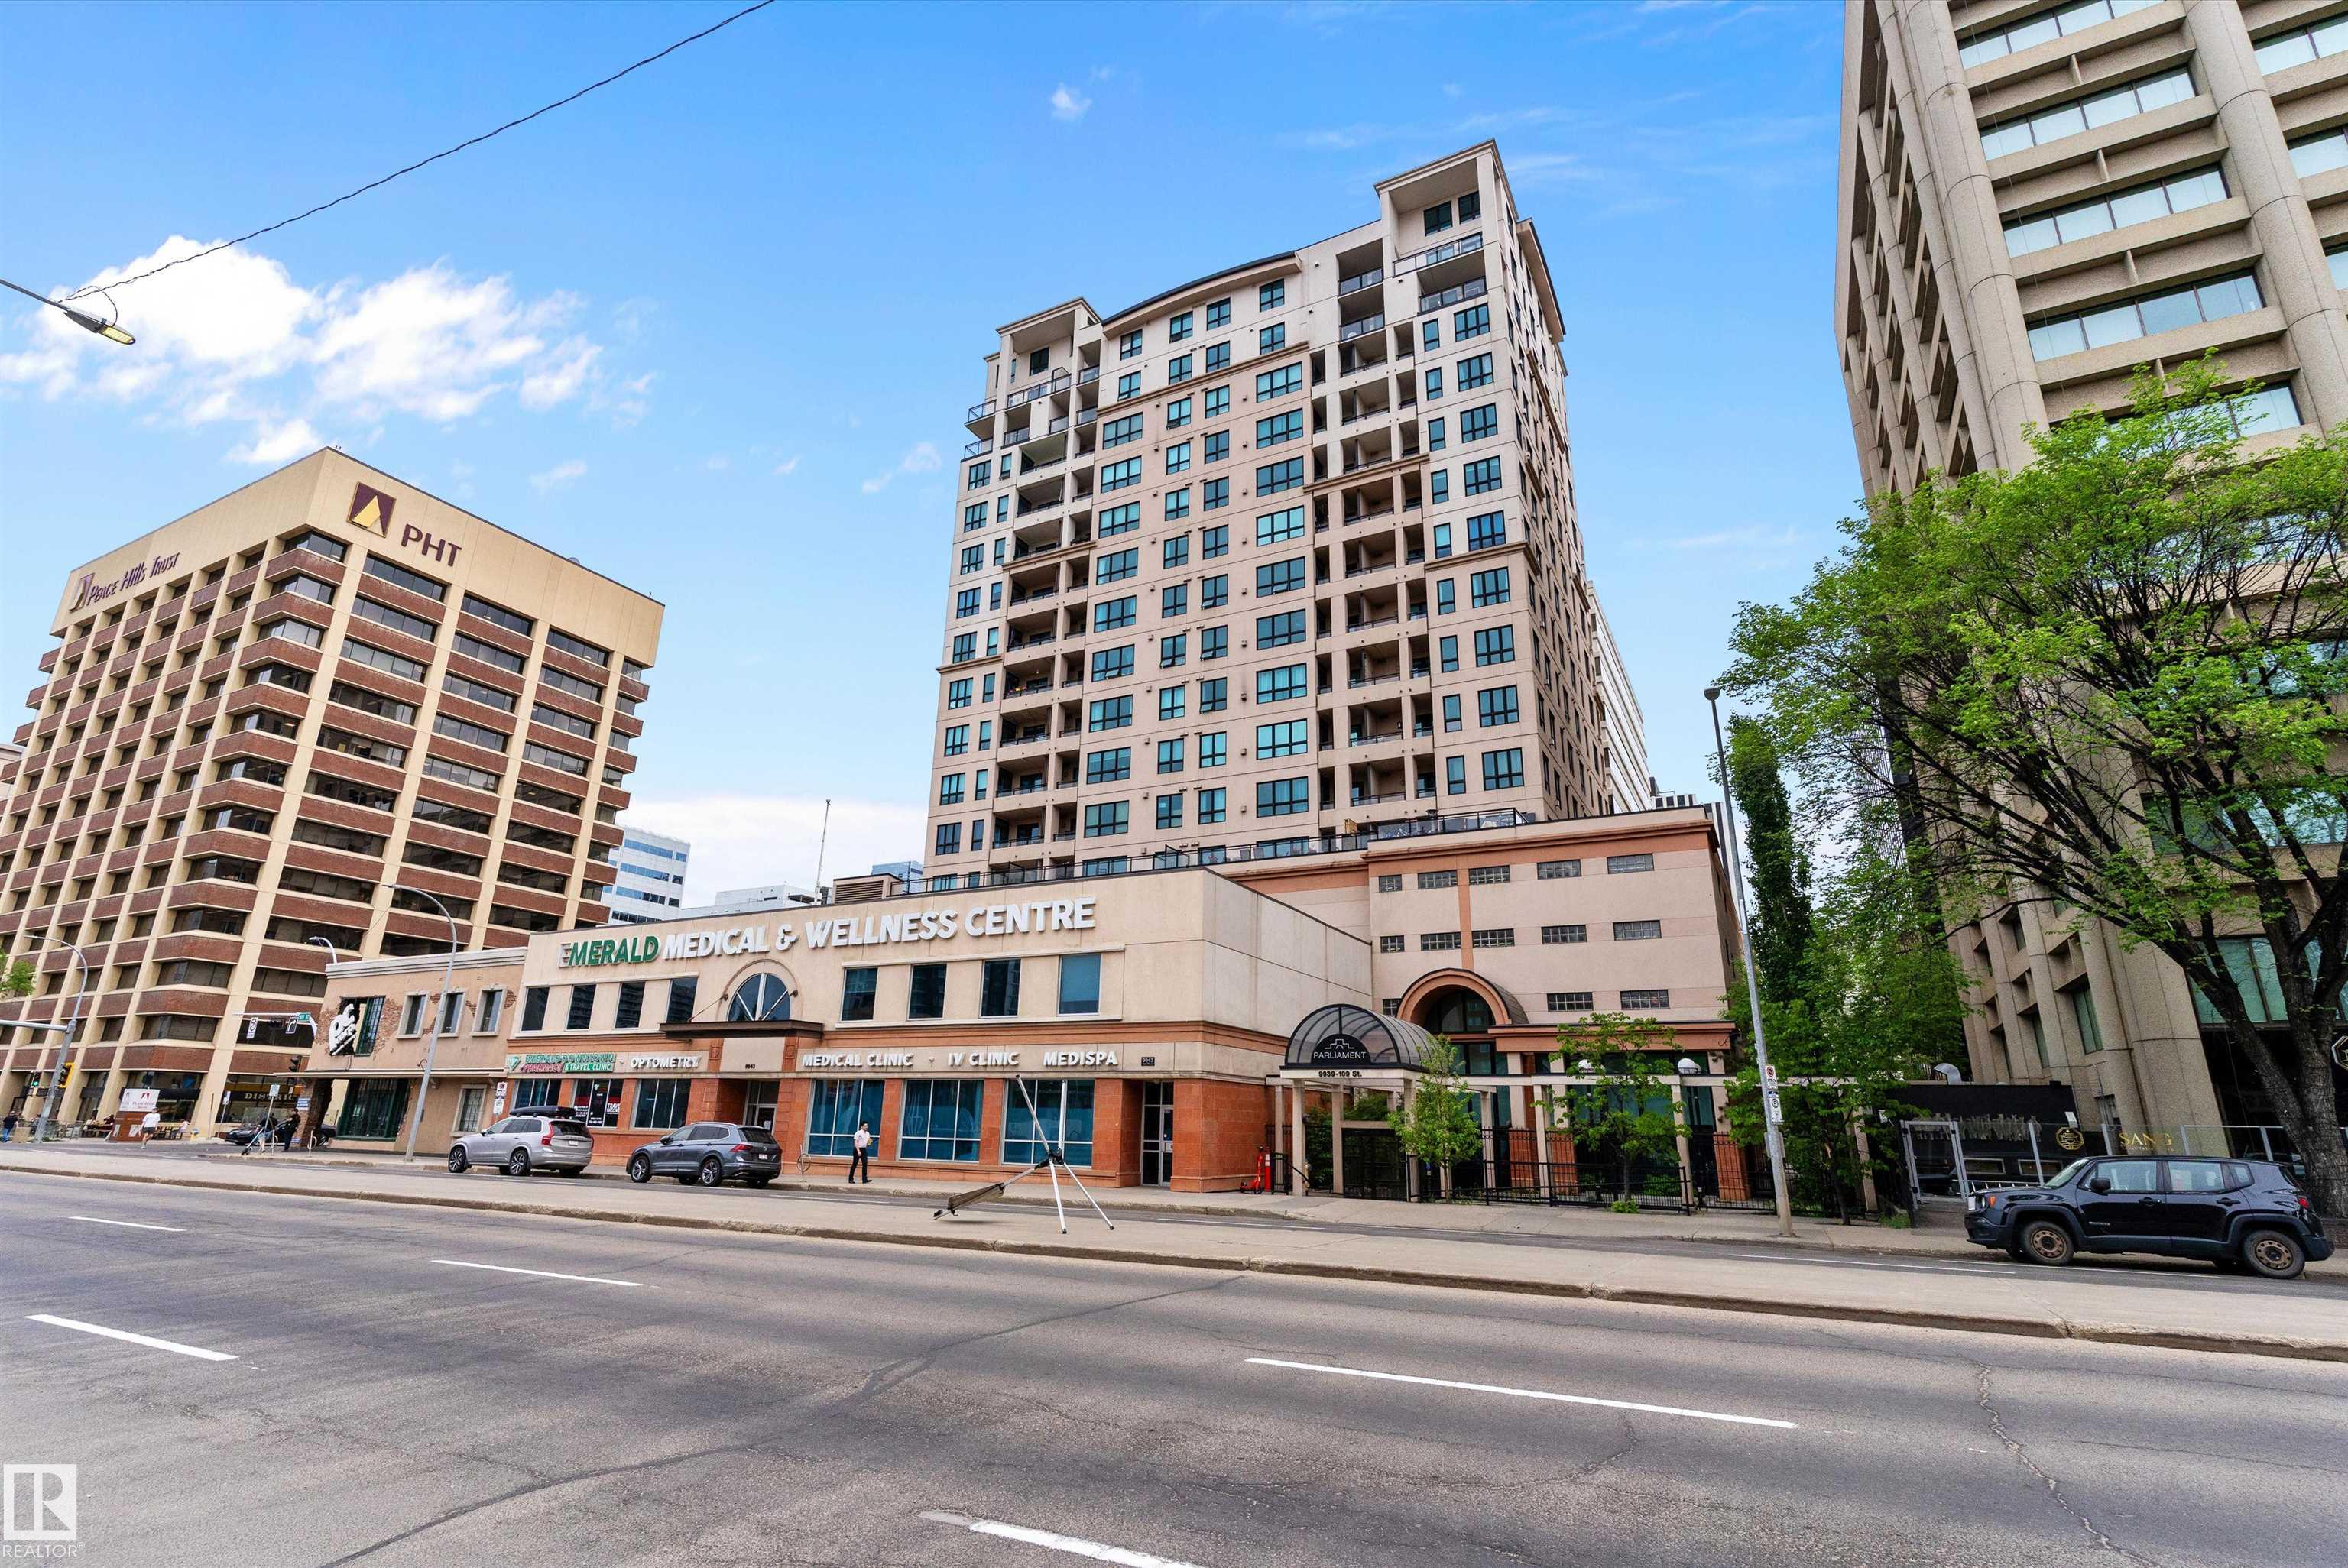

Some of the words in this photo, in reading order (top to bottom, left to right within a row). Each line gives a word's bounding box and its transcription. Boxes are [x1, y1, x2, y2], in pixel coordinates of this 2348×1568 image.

[401, 523, 462, 567] PHT
[559, 936, 660, 968] EMERALD
[662, 928, 770, 961] MEDICAL
[775, 923, 799, 951] &
[806, 909, 958, 948] WELLNESS
[965, 896, 1098, 938] CENTRE
[631, 1056, 701, 1069] OPTOMETRY
[803, 1054, 862, 1067] MEDICAL
[866, 1053, 914, 1067] CLINIC
[947, 1053, 965, 1066] IV
[968, 1052, 1020, 1066] CLINIC
[1043, 1051, 1119, 1067] MEDISPA
[570, 1062, 590, 1071] TRAVEL
[592, 1062, 611, 1071] CLINIC
